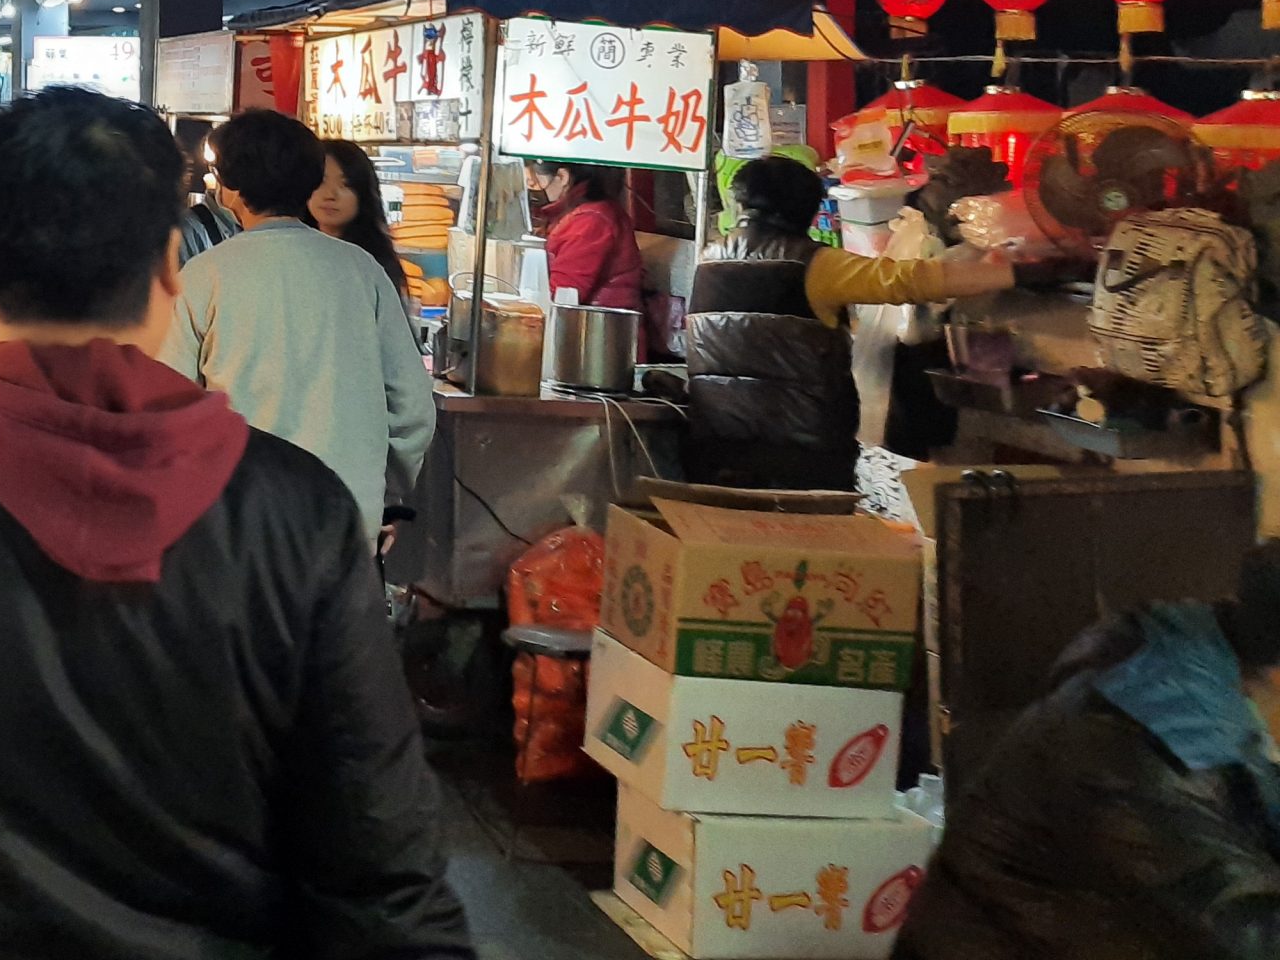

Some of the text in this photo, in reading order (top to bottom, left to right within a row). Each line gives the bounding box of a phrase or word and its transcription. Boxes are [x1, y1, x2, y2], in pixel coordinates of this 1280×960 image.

[524, 30, 576, 58] 新鮮
[596, 36, 618, 64] 簡
[508, 73, 707, 155] 木瓜牛奶
